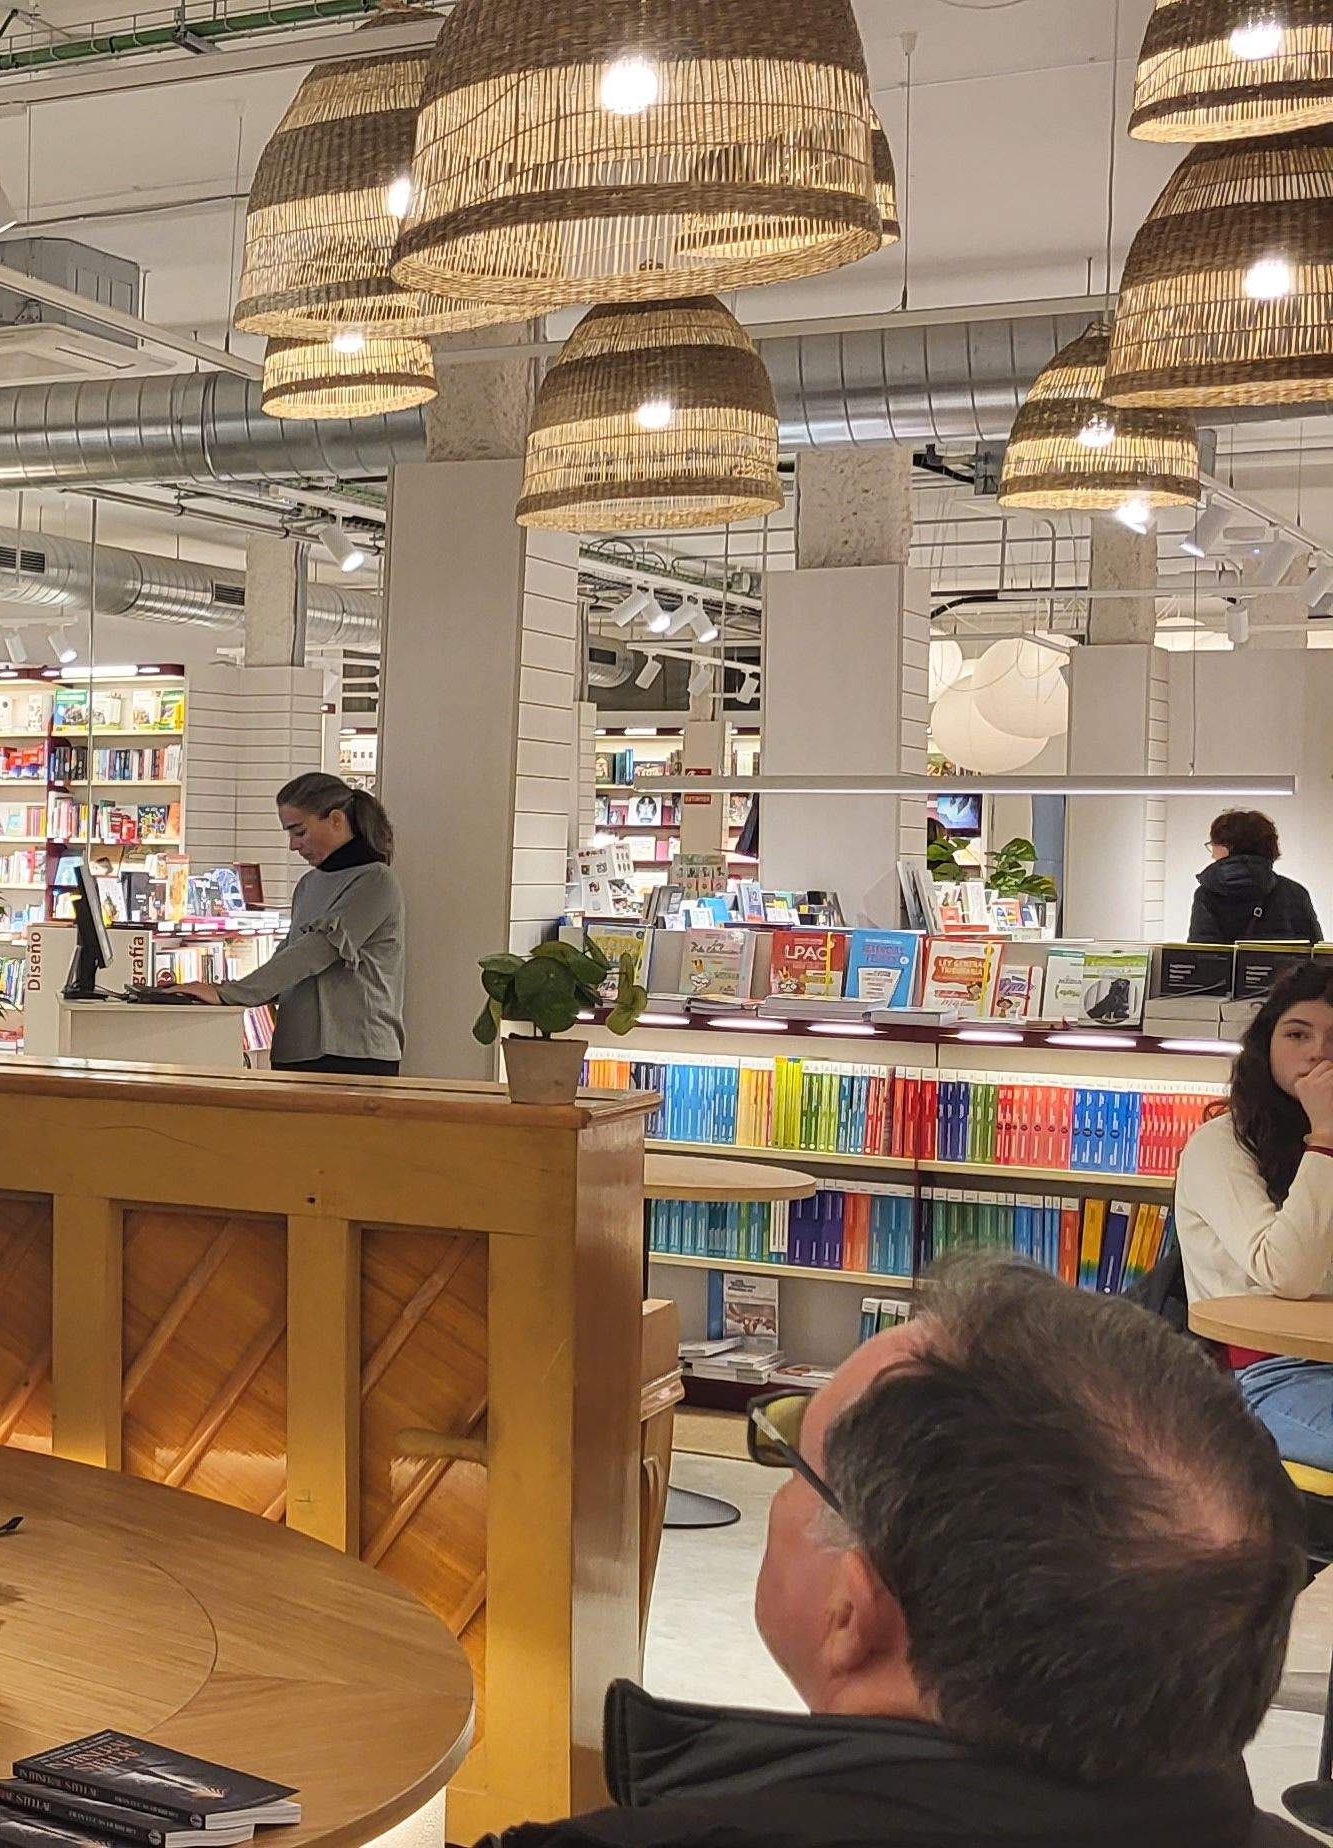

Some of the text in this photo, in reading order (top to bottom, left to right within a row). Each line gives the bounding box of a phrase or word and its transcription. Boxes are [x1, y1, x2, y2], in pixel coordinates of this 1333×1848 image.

[28, 931, 41, 991] Diseño
[129, 935, 144, 986] grafía
[950, 959, 983, 968] GENERA
